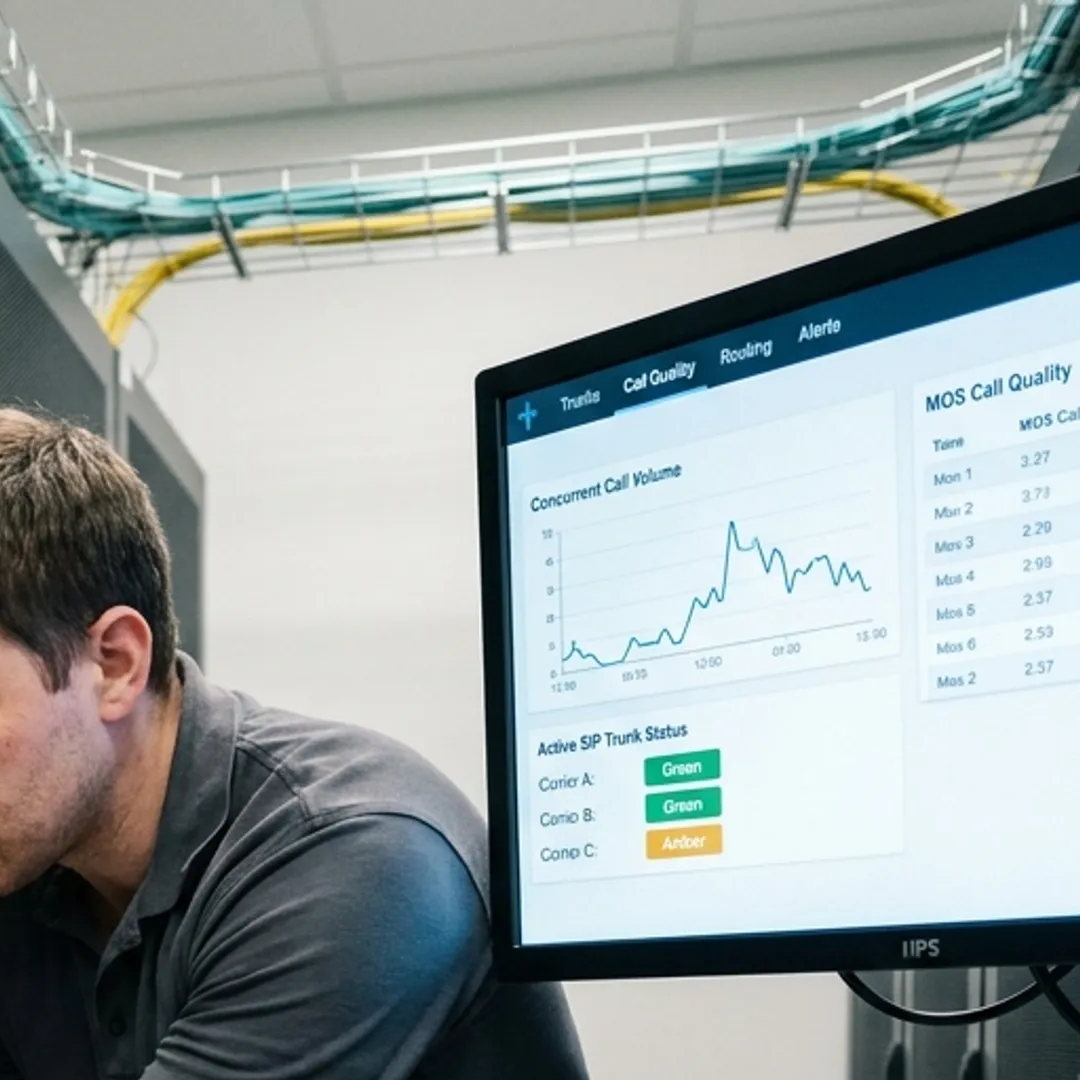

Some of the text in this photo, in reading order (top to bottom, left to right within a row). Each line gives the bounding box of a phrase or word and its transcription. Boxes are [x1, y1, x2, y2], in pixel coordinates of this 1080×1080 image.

[925, 364, 1073, 413] MOS Call Quality
[1019, 412, 1054, 432] MOS
[537, 738, 577, 756] Active
[604, 728, 643, 747] Trunk
